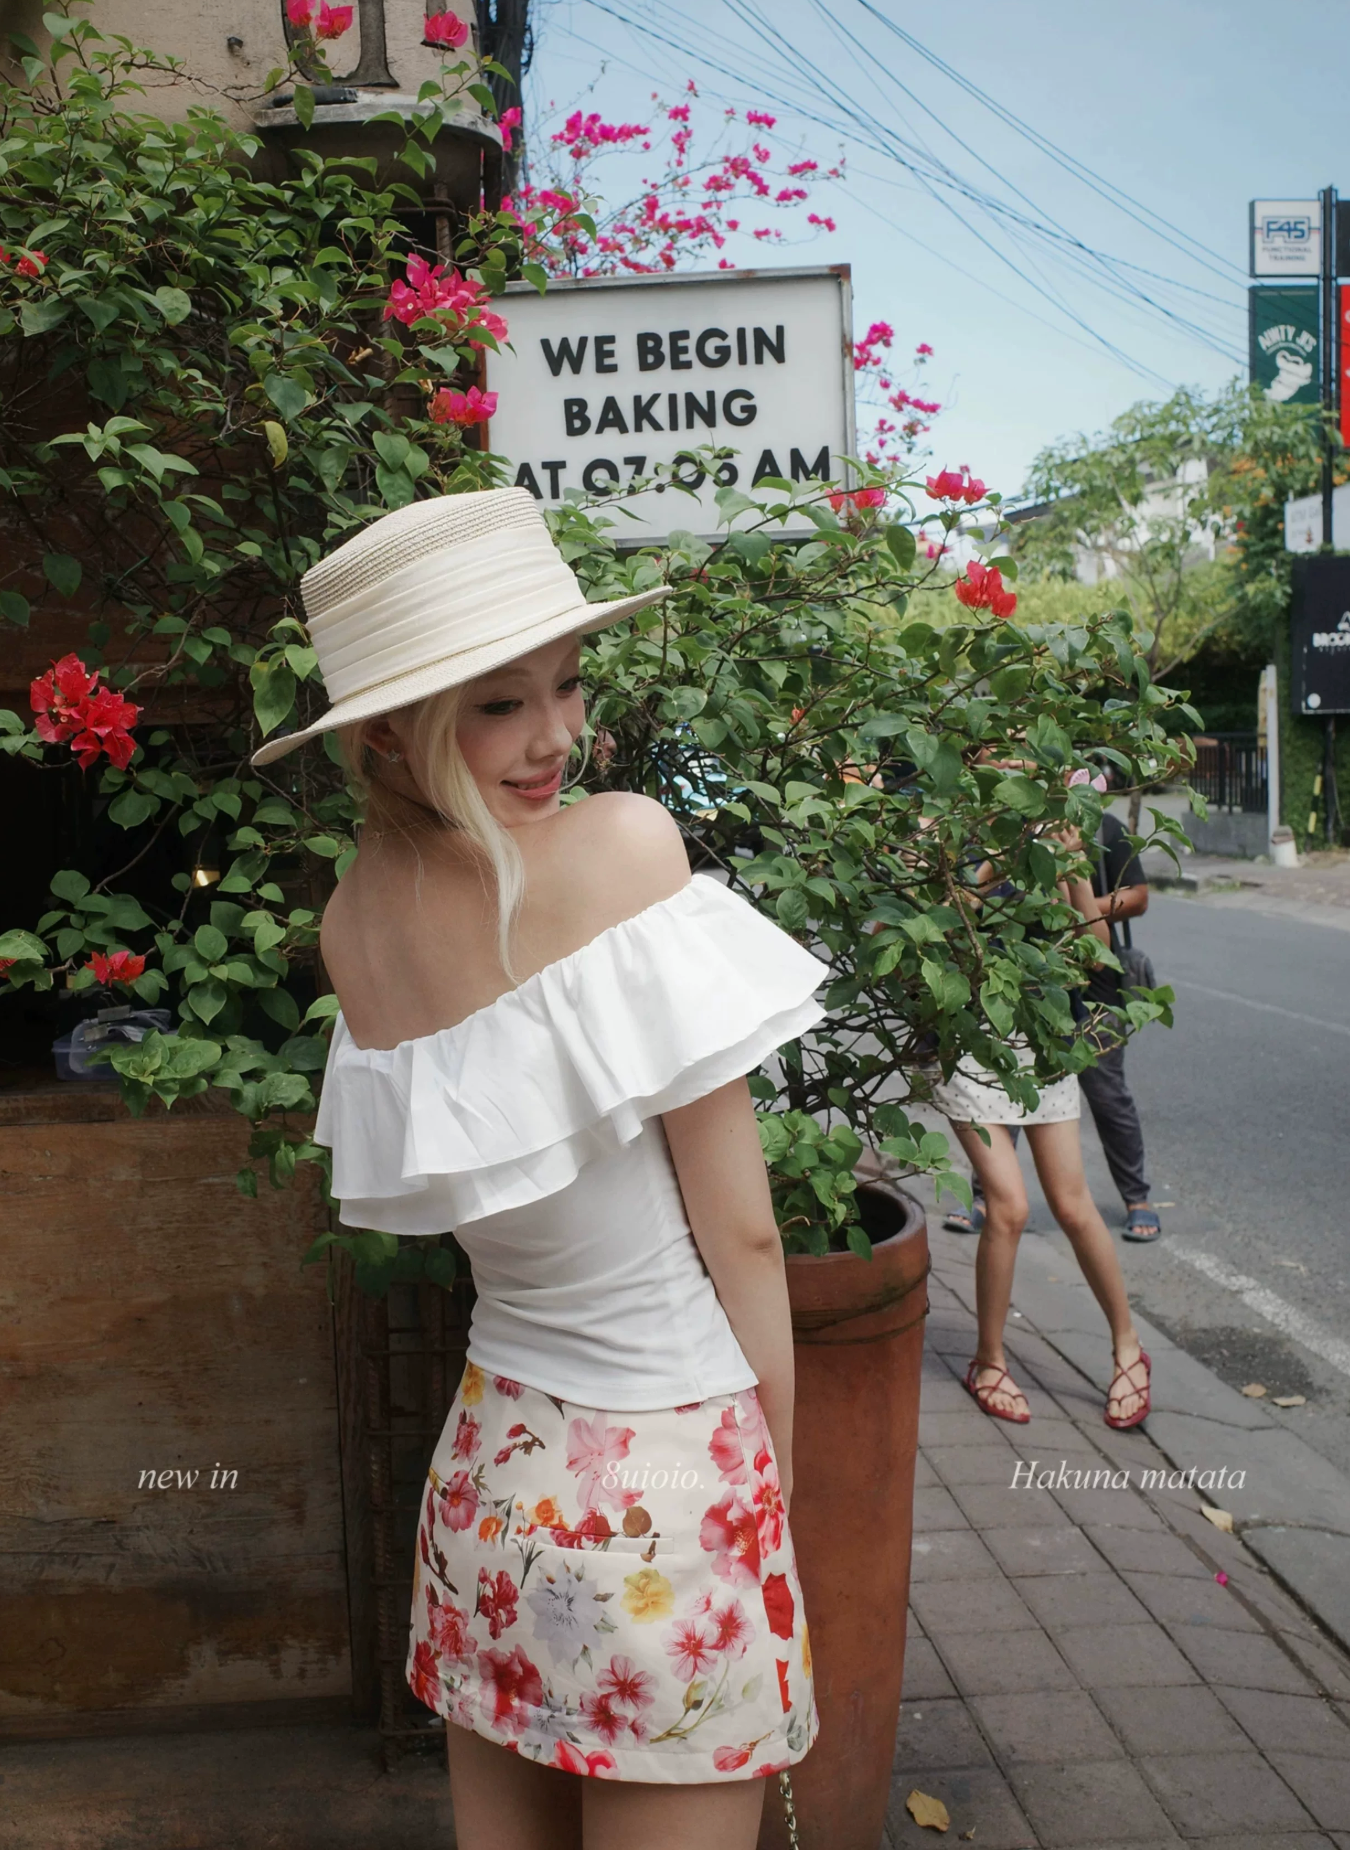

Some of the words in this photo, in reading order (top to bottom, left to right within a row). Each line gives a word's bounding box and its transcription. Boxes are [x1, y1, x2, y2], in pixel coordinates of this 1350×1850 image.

[1265, 219, 1307, 240] F45
[540, 334, 618, 377] WE
[636, 325, 786, 372] BEGIN
[563, 389, 757, 437] BAKING
[513, 460, 567, 500] AT
[751, 446, 831, 486] AM
